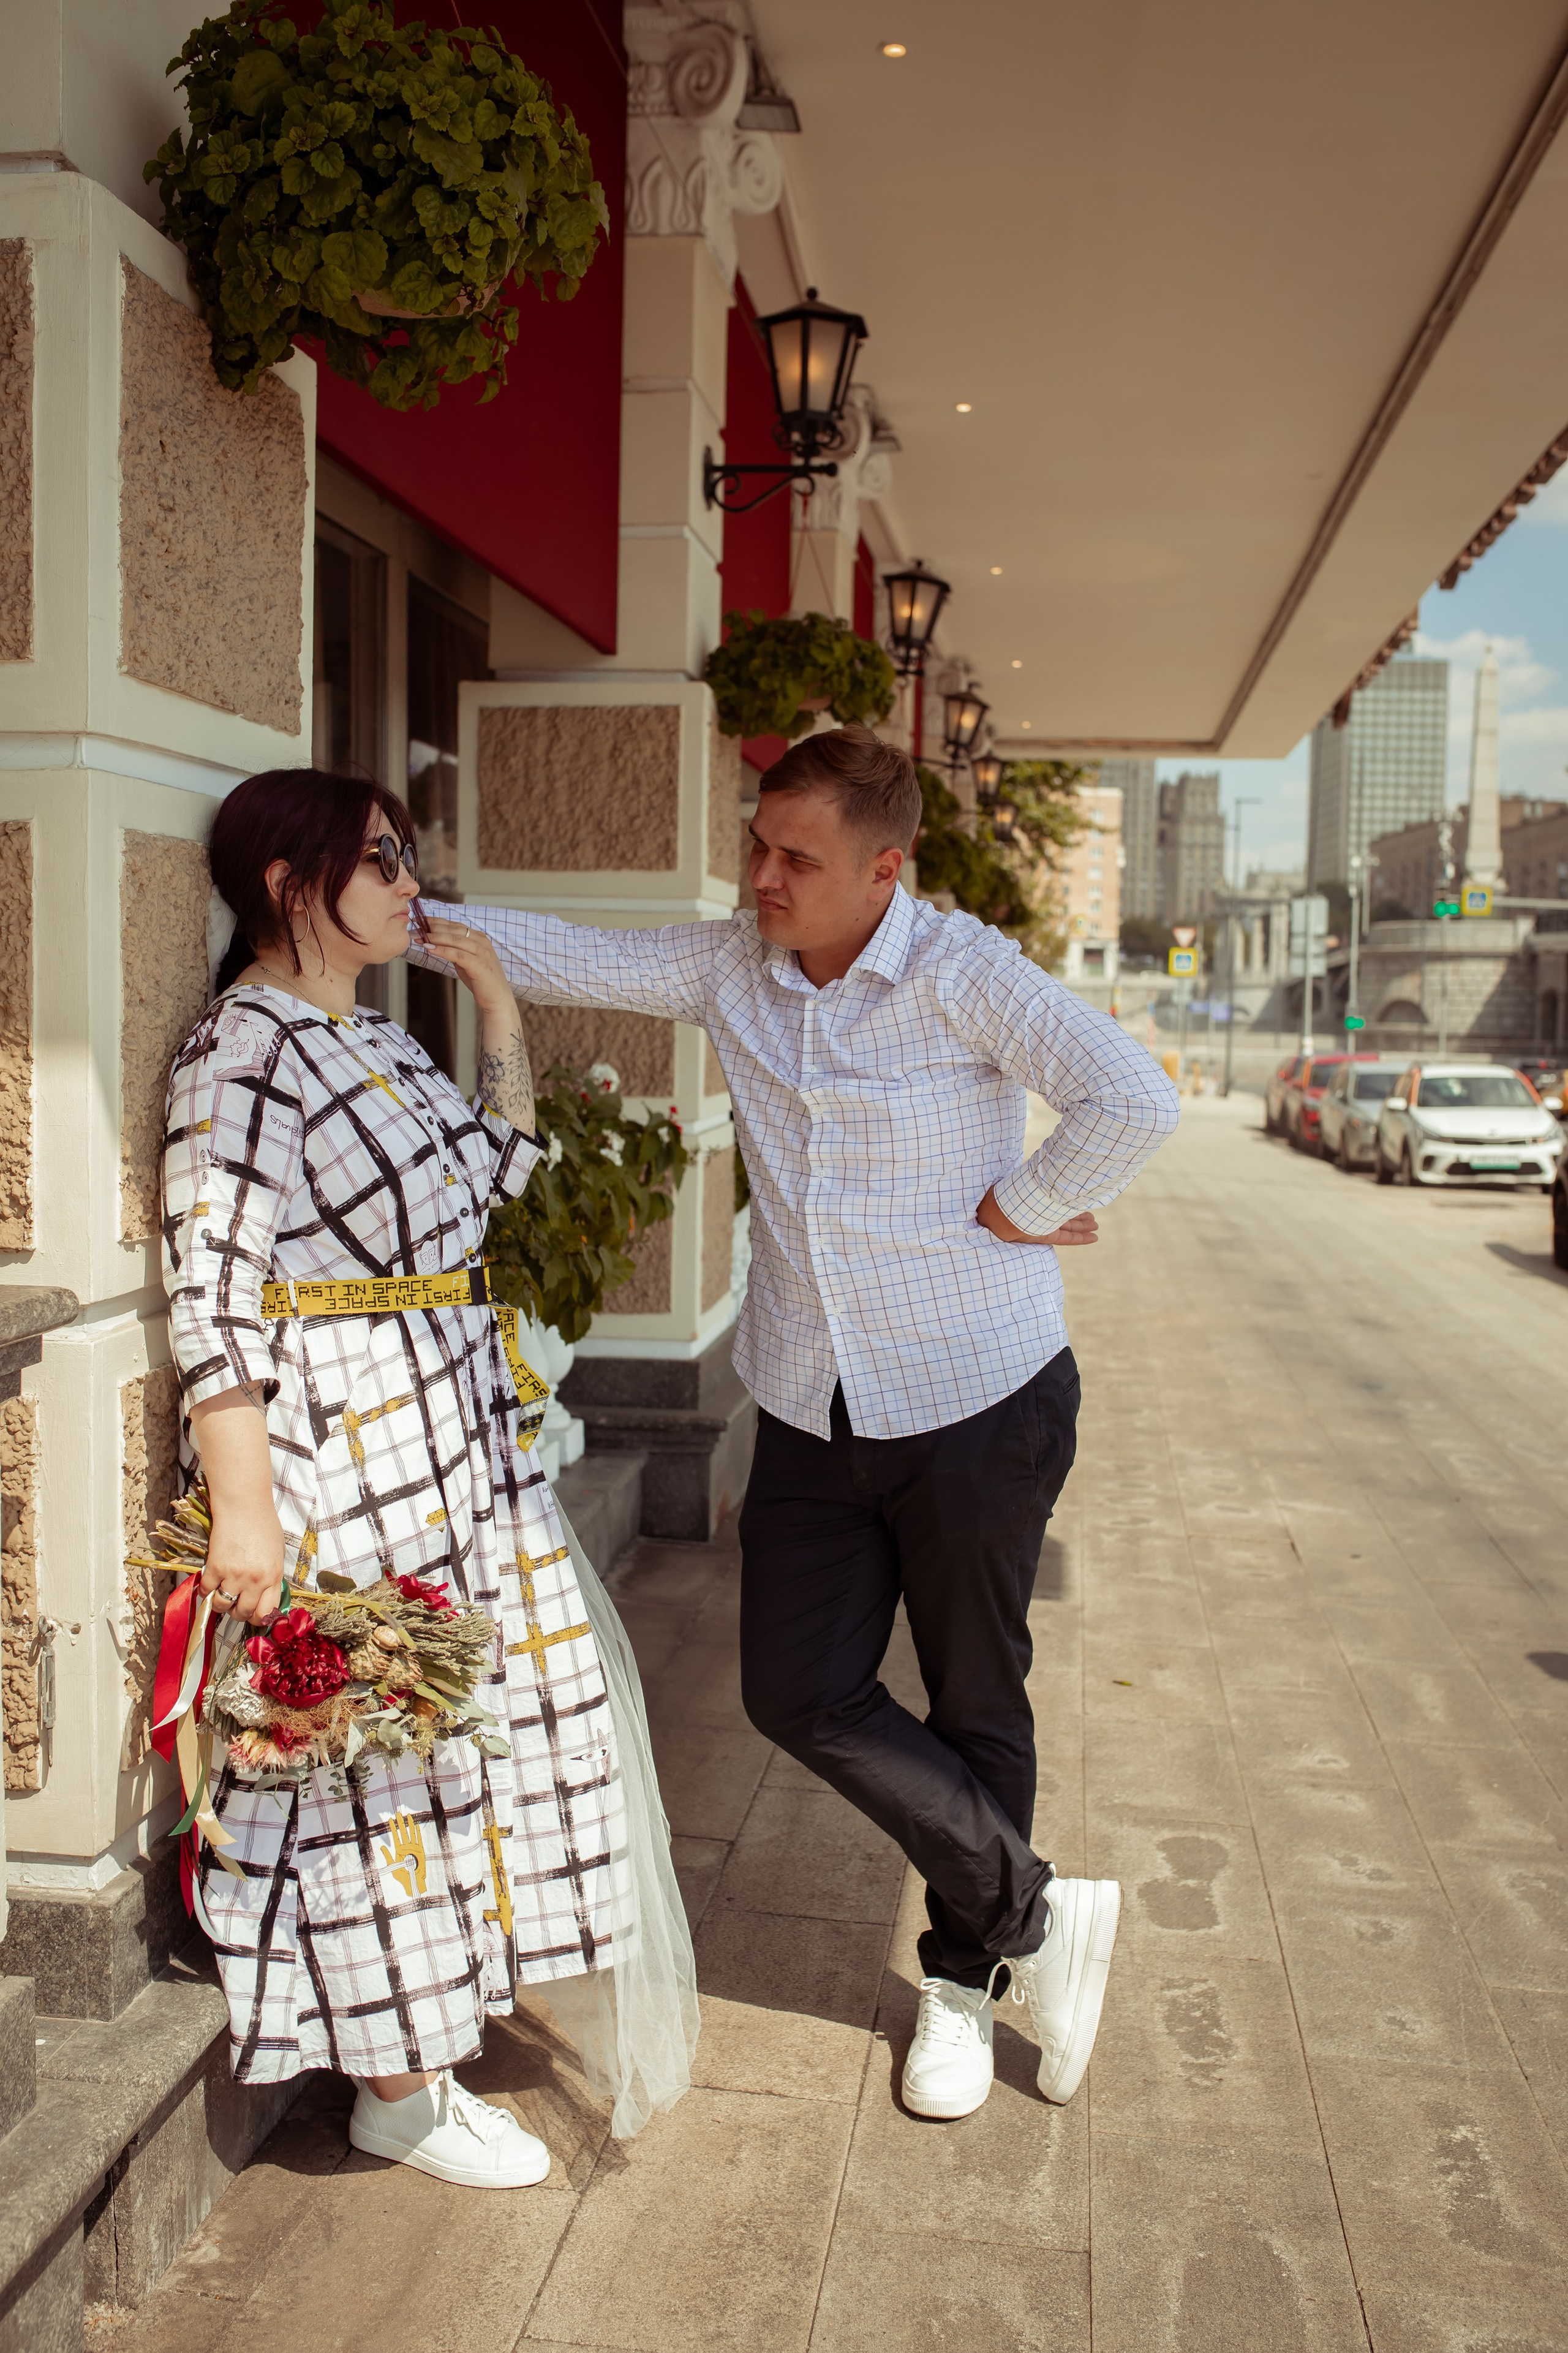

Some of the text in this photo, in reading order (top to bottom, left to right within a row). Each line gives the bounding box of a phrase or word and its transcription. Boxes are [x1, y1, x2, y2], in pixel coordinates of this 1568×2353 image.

[274, 1280, 432, 1299] FRST IN SPACE
[423, 1288, 471, 1305] FIRST
[325, 1296, 390, 1310] SPACE
[396, 1294, 418, 1306] IN
